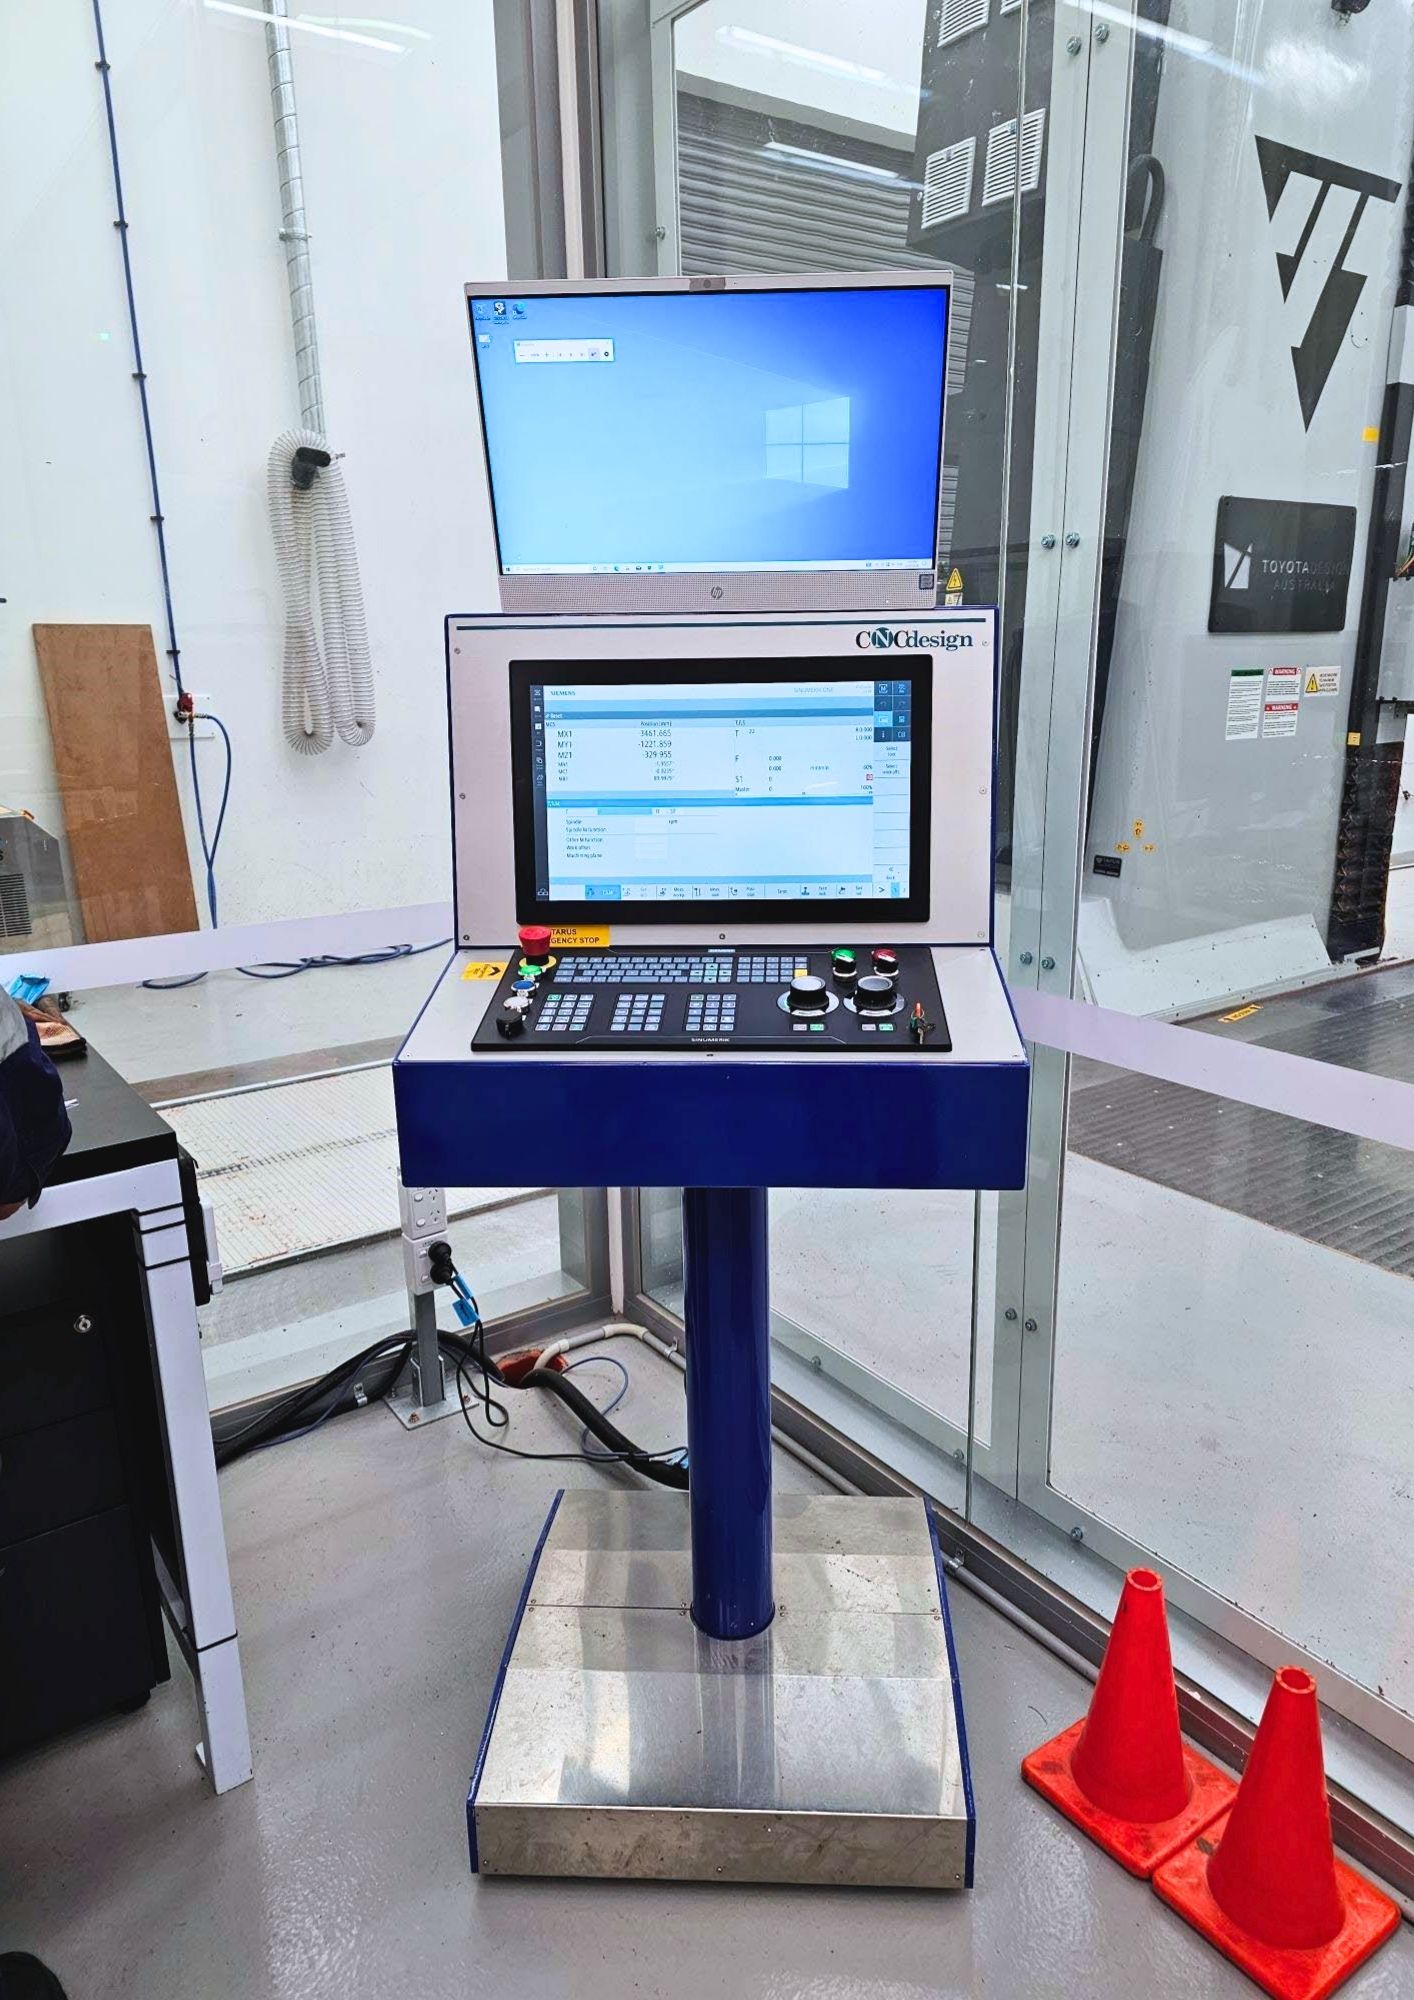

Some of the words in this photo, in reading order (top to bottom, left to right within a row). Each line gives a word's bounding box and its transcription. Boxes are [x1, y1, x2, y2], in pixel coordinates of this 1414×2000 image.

[1262, 560, 1309, 574] TOYOTA
[1274, 579, 1335, 592] AUSTRALIA
[856, 627, 974, 651] CNCdesign
[557, 730, 572, 738] MX1
[557, 751, 572, 759] MZ1
[580, 936, 600, 944] STOP
